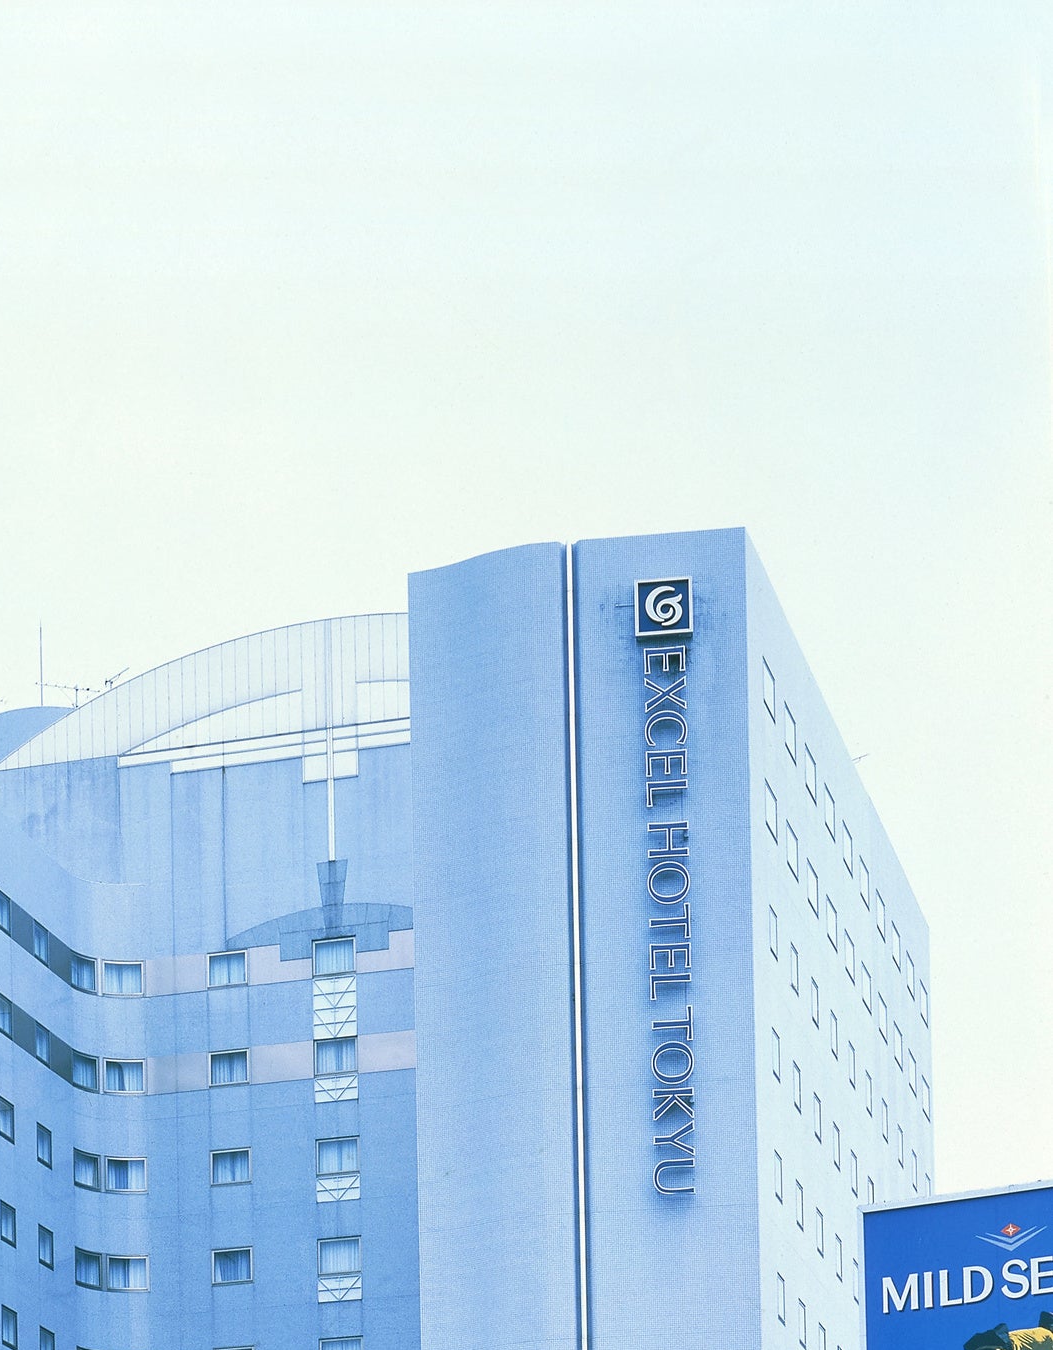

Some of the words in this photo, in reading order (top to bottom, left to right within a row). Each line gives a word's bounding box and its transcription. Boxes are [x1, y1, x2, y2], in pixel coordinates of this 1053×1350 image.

[642, 645, 688, 809] EXCEL
[646, 819, 691, 1002] HOTEL
[650, 1004, 696, 1197] TOKYU
[882, 1264, 994, 1314] MILD
[1001, 1255, 1053, 1300] SE
